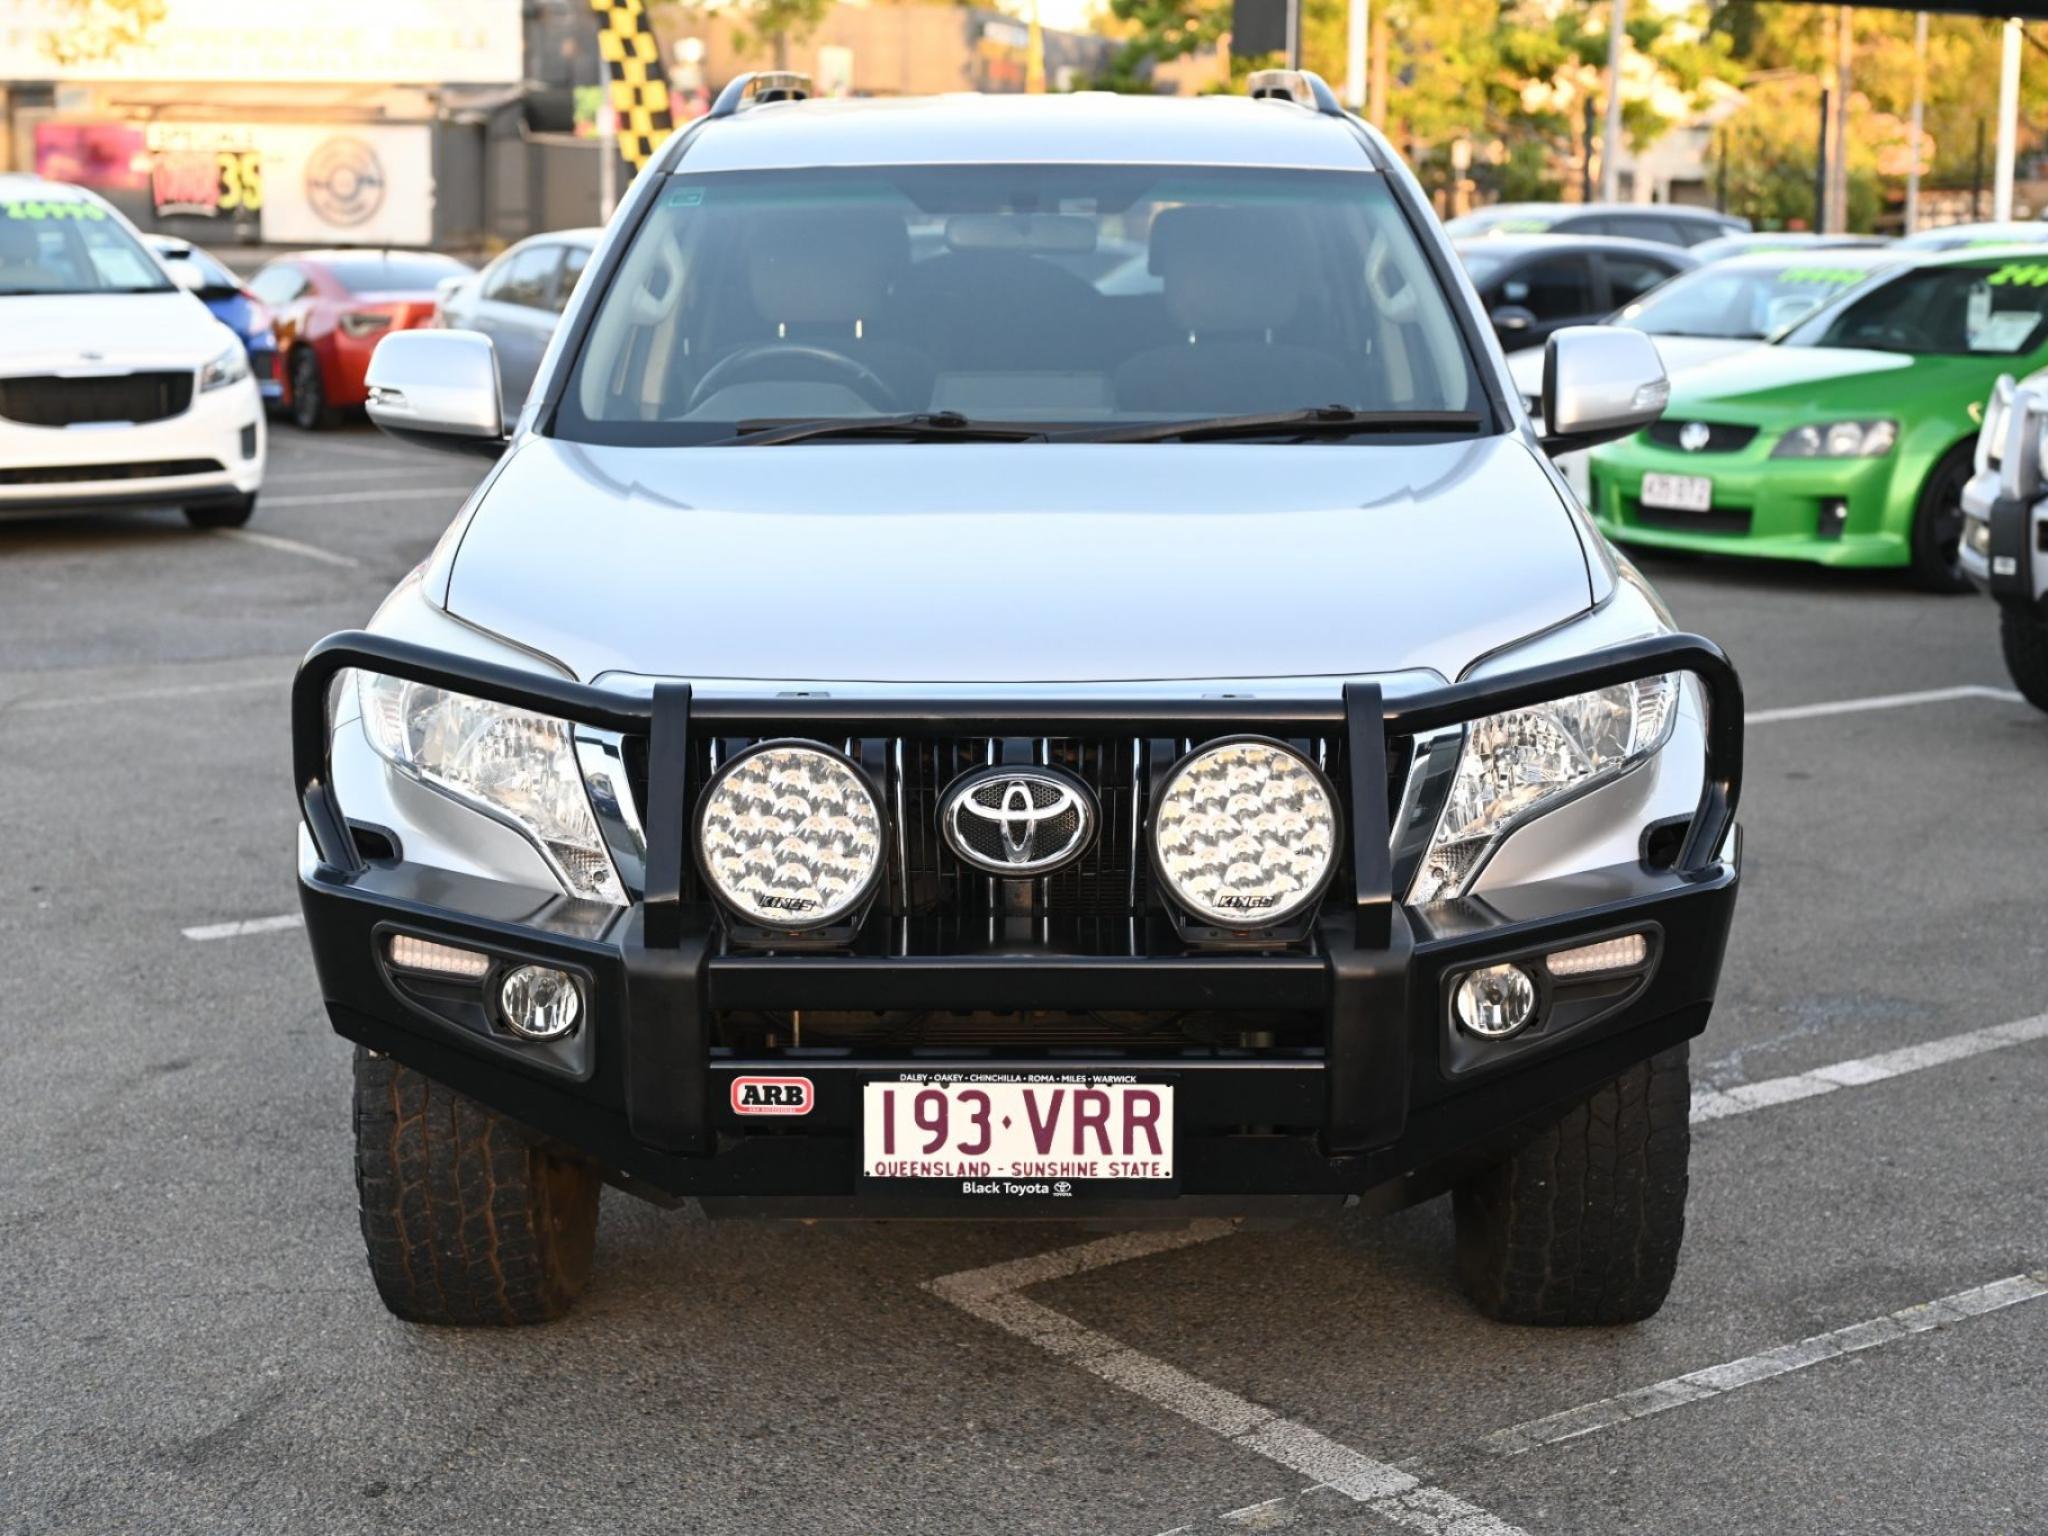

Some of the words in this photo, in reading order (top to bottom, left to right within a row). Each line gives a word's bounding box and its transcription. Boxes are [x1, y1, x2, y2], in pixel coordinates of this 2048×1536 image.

[758, 895, 816, 911] KINGS
[1216, 895, 1275, 907] KINGS
[900, 1073, 928, 1081] DALBY
[933, 1073, 964, 1081] OAKEY
[969, 1074, 1021, 1082] CHINCHILLA
[1027, 1074, 1055, 1082] ROMA
[1061, 1074, 1086, 1082] MILES
[1092, 1075, 1137, 1083] WARWICK
[741, 1085, 804, 1105] ARB
[875, 1161, 991, 1176] QUEENSLAND
[1011, 1161, 1098, 1177] SUNSHINE
[1109, 1161, 1160, 1177] STATE
[962, 1181, 1000, 1194] Black
[1003, 1182, 1050, 1196] Toyota
